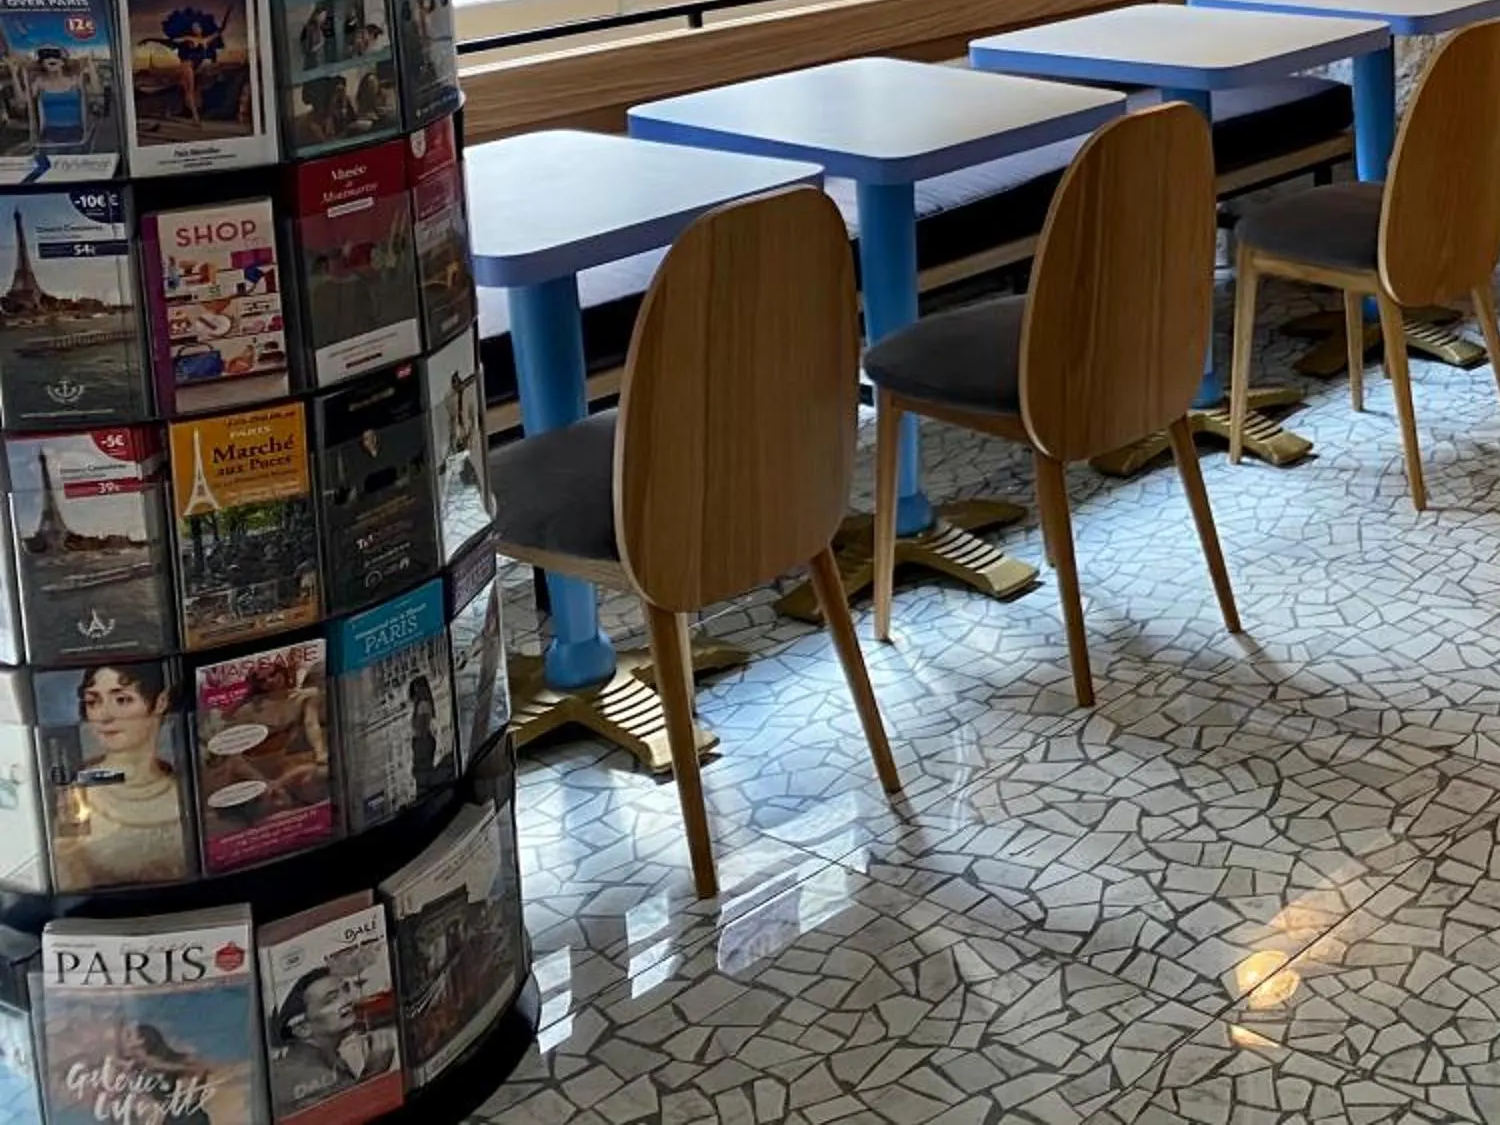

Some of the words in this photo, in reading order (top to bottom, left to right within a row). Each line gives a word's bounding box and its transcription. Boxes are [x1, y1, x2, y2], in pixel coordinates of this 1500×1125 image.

[174, 219, 257, 248] SHOP
[212, 434, 295, 466] Marché
[364, 615, 418, 653] PARIS
[55, 945, 208, 986] PARIS
